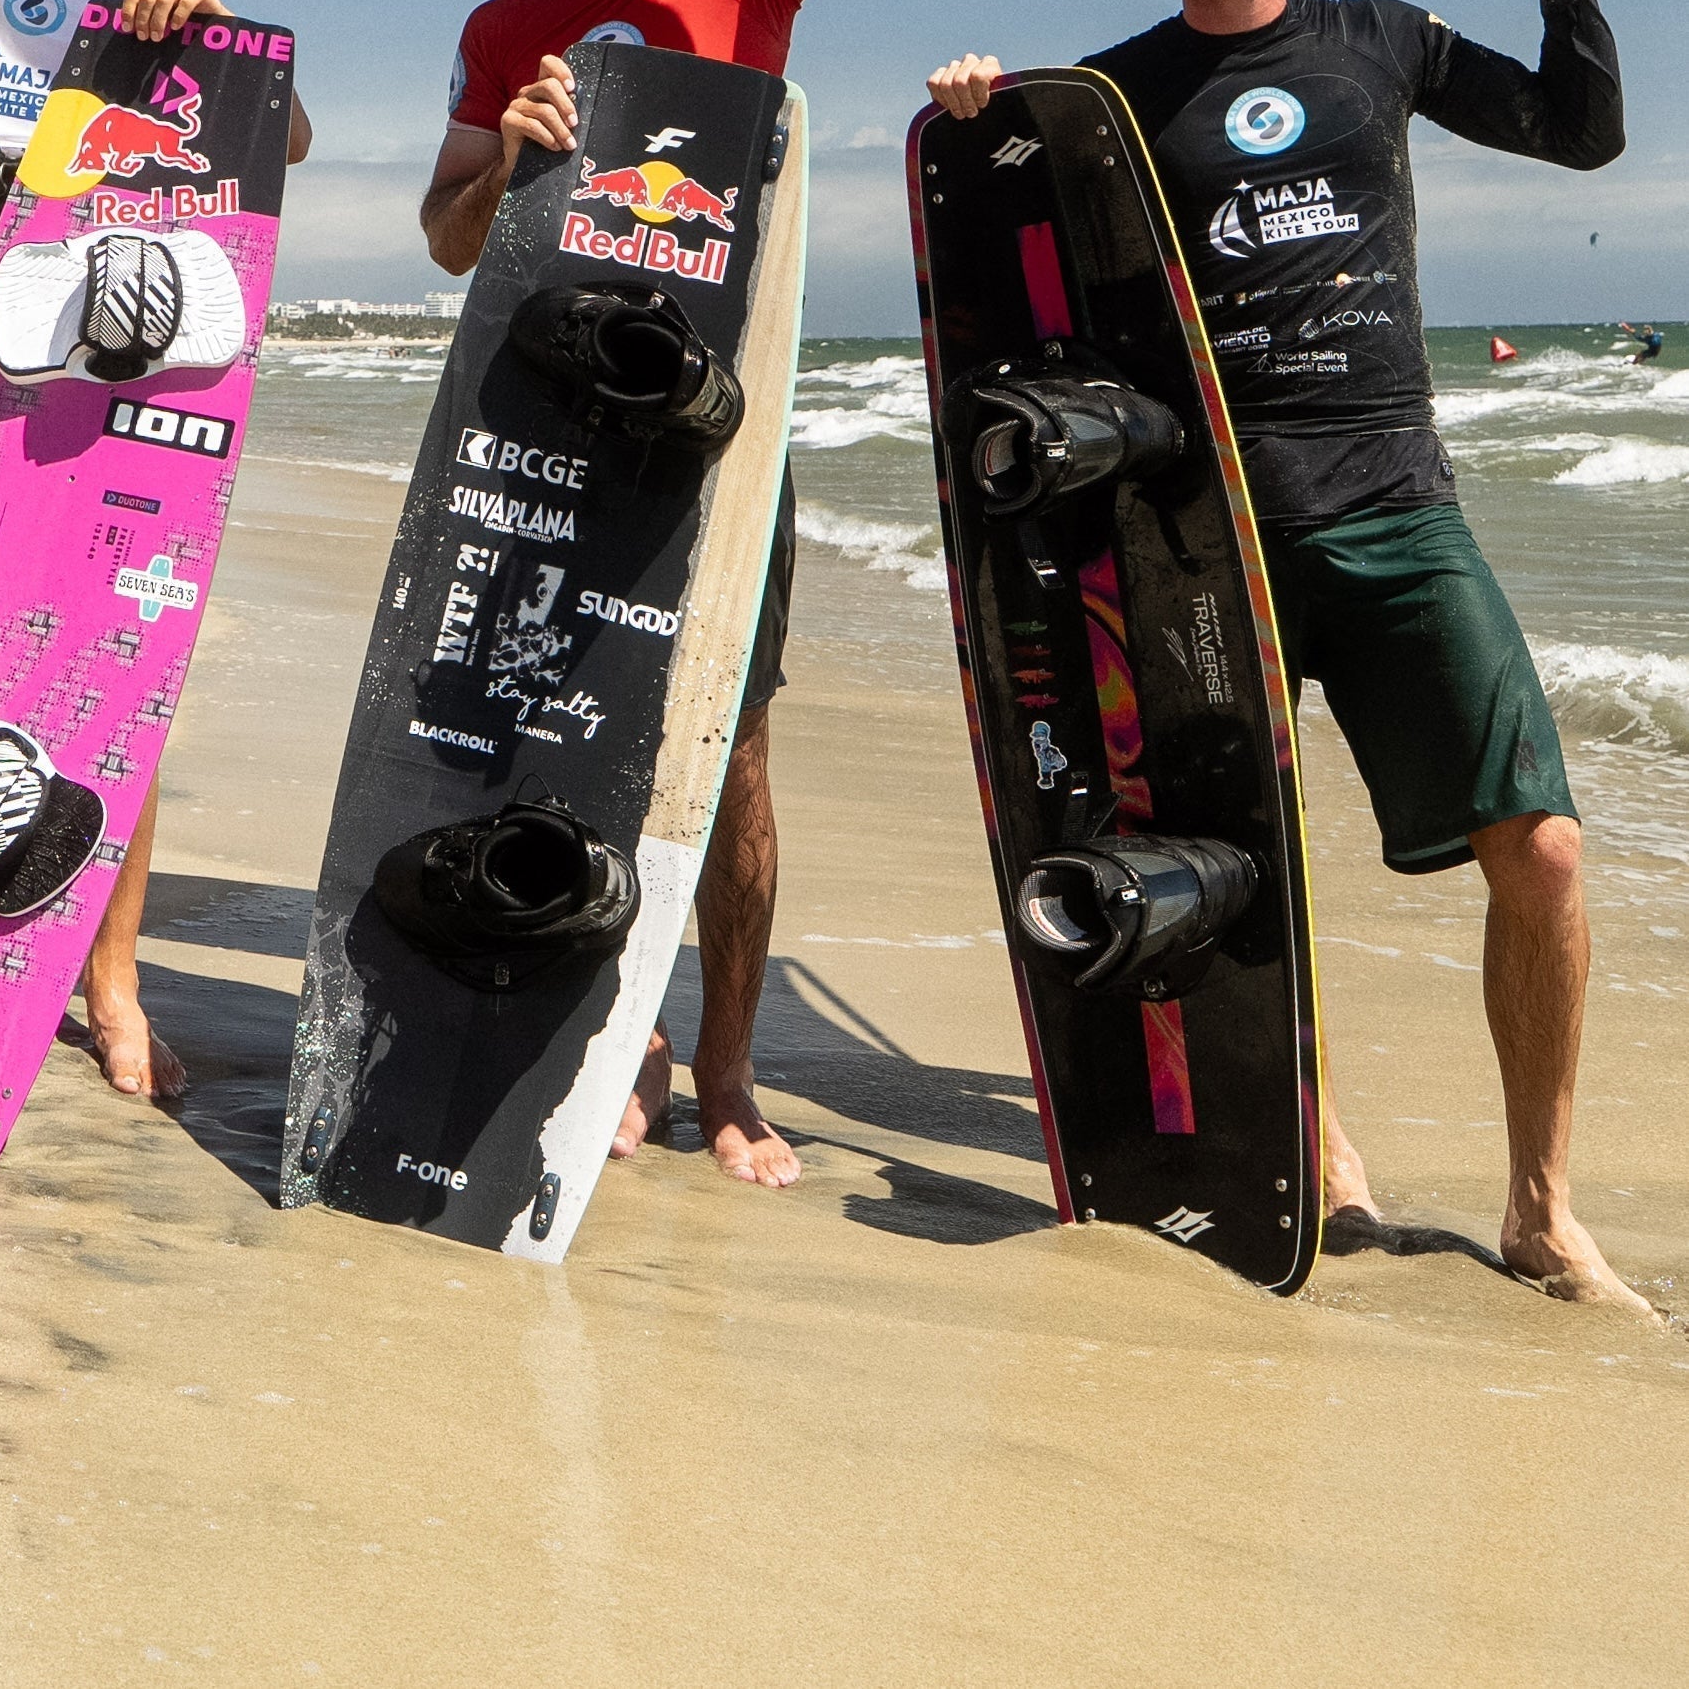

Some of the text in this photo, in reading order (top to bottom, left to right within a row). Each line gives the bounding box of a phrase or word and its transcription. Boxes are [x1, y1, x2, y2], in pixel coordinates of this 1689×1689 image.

[80, 3, 293, 62] DTONE
[1251, 88, 1284, 98] WORLD
[95, 179, 239, 226] Red Bull
[1253, 177, 1334, 213] MAJA
[1263, 207, 1330, 227] MEXICO
[1265, 217, 1357, 240] KITE TOUR
[560, 212, 730, 284] Red Bull
[1323, 311, 1393, 327] KOVA
[1213, 333, 1271, 349] VIENTO
[1275, 350, 1347, 362] World Sailing
[1275, 362, 1348, 374] Special Event
[498, 441, 588, 490] BCGE
[118, 497, 157, 511] DUOTONE
[449, 486, 575, 541] SILVAPLANA
[518, 530, 553, 544] CORVATSCH
[107, 528, 128, 586] FREESTYLE
[119, 575, 158, 594] SEVEN
[160, 583, 195, 603] SEA'S
[433, 581, 478, 662] WTF
[576, 591, 679, 637] SUNGOD
[1209, 592, 1223, 648] NAISH
[1192, 592, 1223, 703] TRAVERSE
[486, 675, 606, 739] stay salty
[409, 720, 495, 754] BLACKROLL
[514, 724, 563, 744] MANERA
